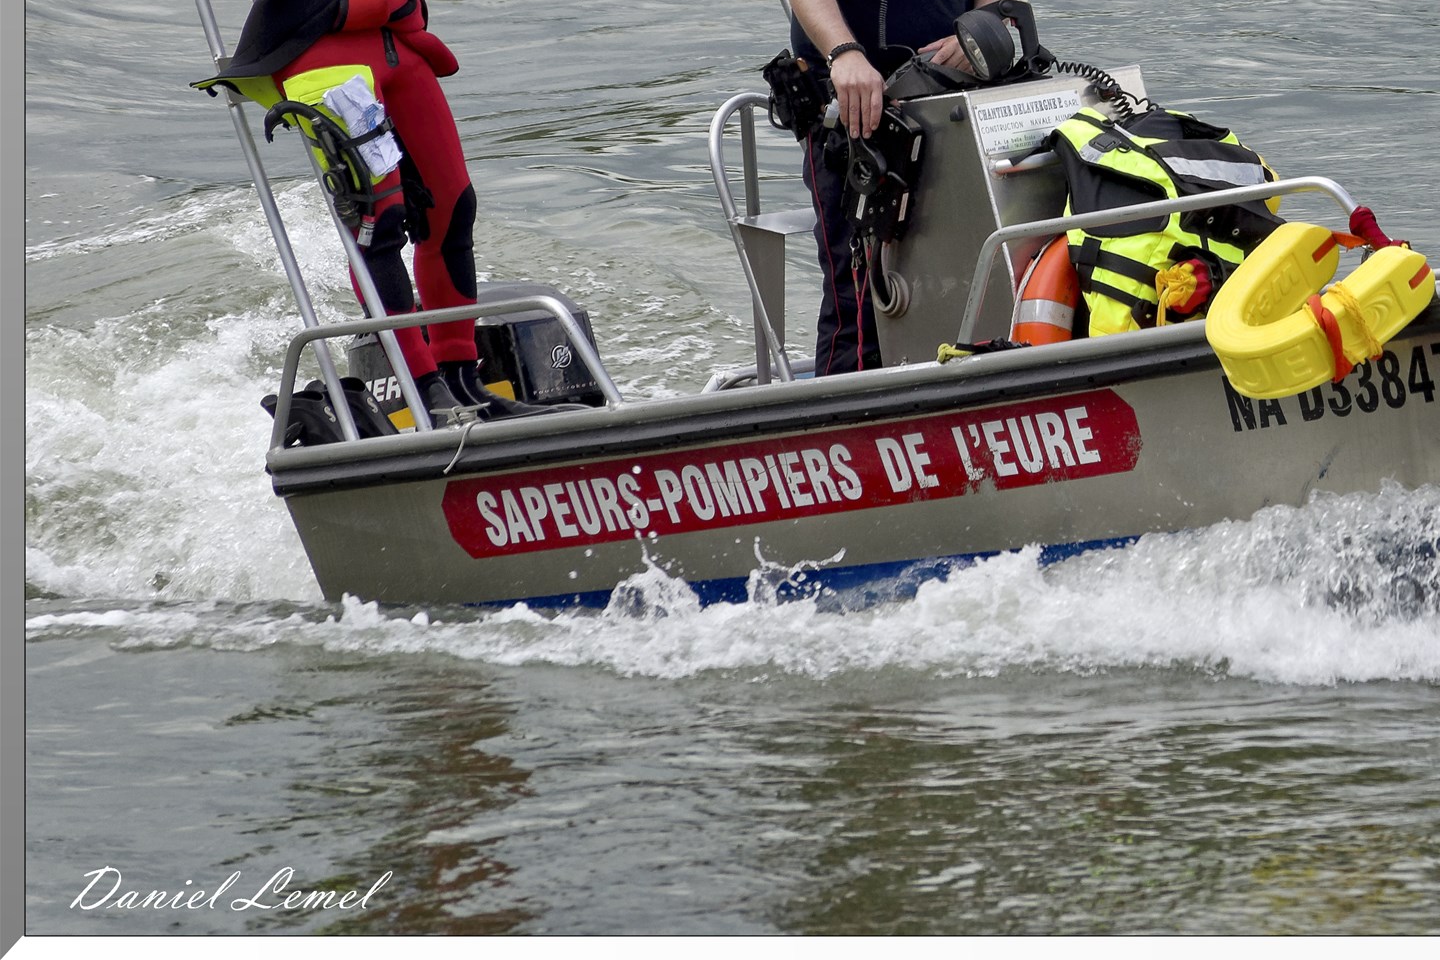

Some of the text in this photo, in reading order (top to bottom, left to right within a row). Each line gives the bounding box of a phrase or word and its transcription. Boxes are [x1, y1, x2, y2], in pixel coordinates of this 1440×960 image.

[977, 105, 1013, 122] CHANTIER
[1012, 97, 1058, 117] DELAVERGNE
[1064, 99, 1079, 108] SARL
[980, 121, 1024, 135] CONSTRUCTION
[1030, 116, 1052, 126] NAVALE
[476, 406, 1101, 547] SAPEURS-POMPIERS DE L'EURE
